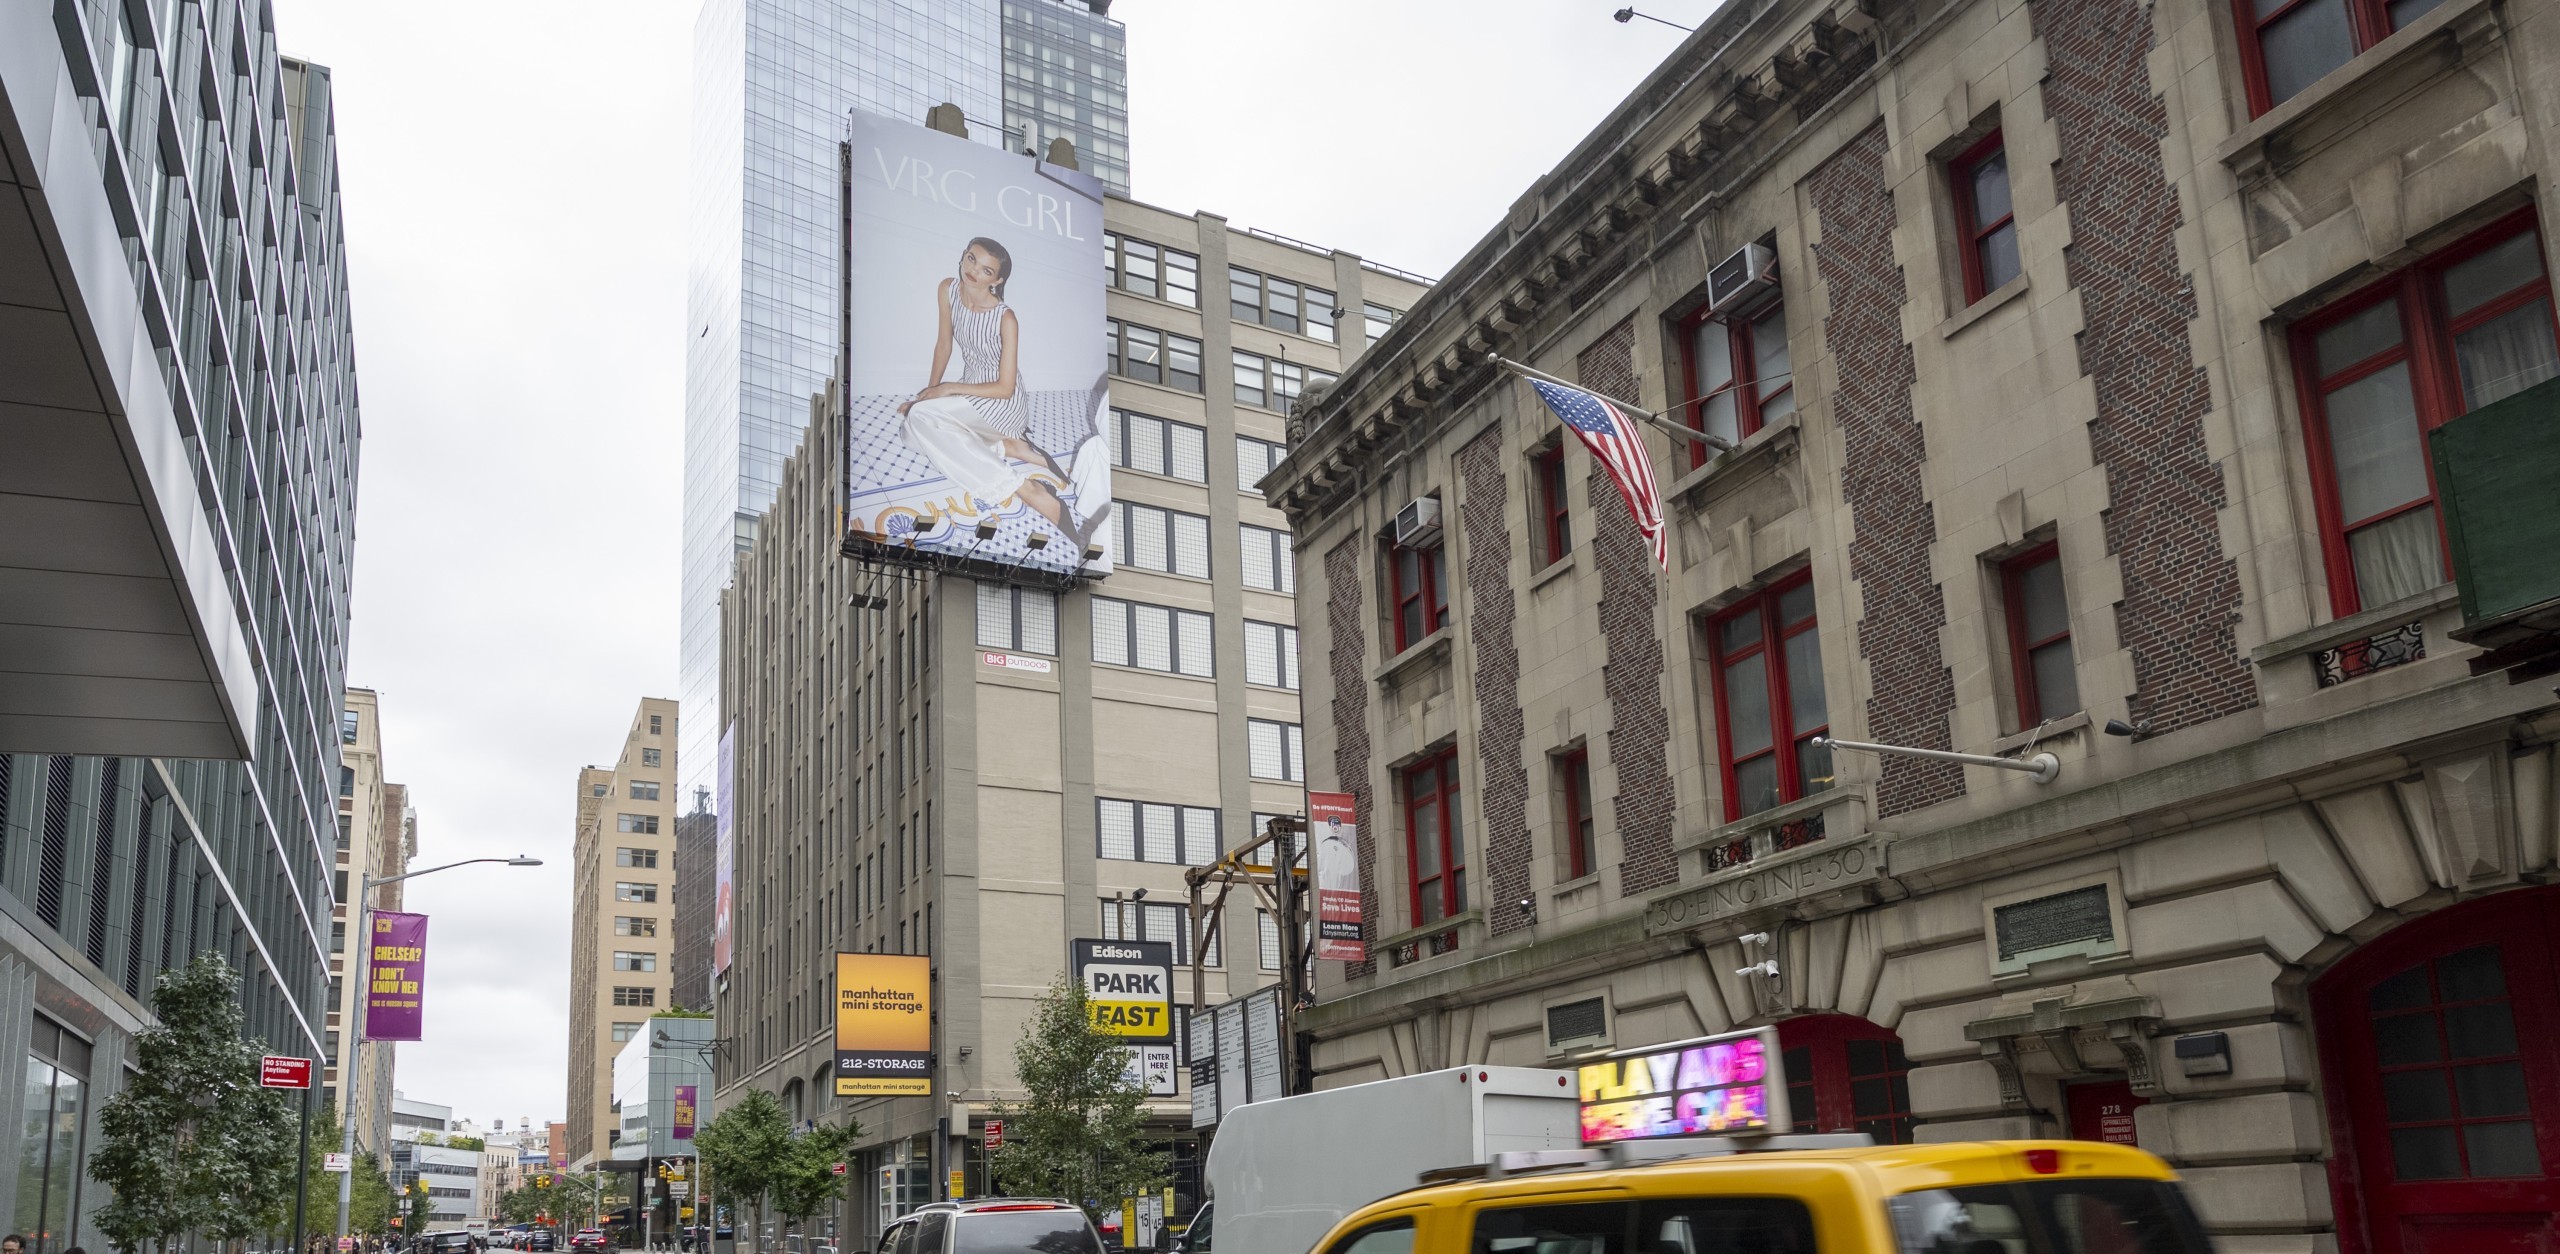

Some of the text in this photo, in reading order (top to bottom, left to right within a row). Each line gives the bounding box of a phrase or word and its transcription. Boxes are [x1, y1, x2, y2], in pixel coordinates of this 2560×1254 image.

[874, 146, 1085, 242] VRG GRL
[986, 654, 1047, 669] BIG OUTDOOR
[1322, 903, 1360, 912] Save Lives
[1322, 922, 1341, 930] Learn
[1322, 930, 1359, 939] fdnysmart.org
[374, 946, 422, 962] CHELSEA?
[1092, 945, 1142, 959] Edison
[373, 967, 405, 981] I DON'T
[372, 980, 418, 994] KNOW HER
[1093, 972, 1161, 994] PARK
[842, 985, 914, 1001] manhattan
[842, 999, 923, 1014] mini storage
[1096, 1005, 1160, 1027] FAST
[275, 1060, 305, 1068] STANDING
[842, 1058, 925, 1069] 212-STORAGE
[1147, 1053, 1170, 1061] ENTER
[265, 1066, 290, 1074] Anytime
[842, 1082, 881, 1090] manhattan
[2101, 1105, 2121, 1115] 278
